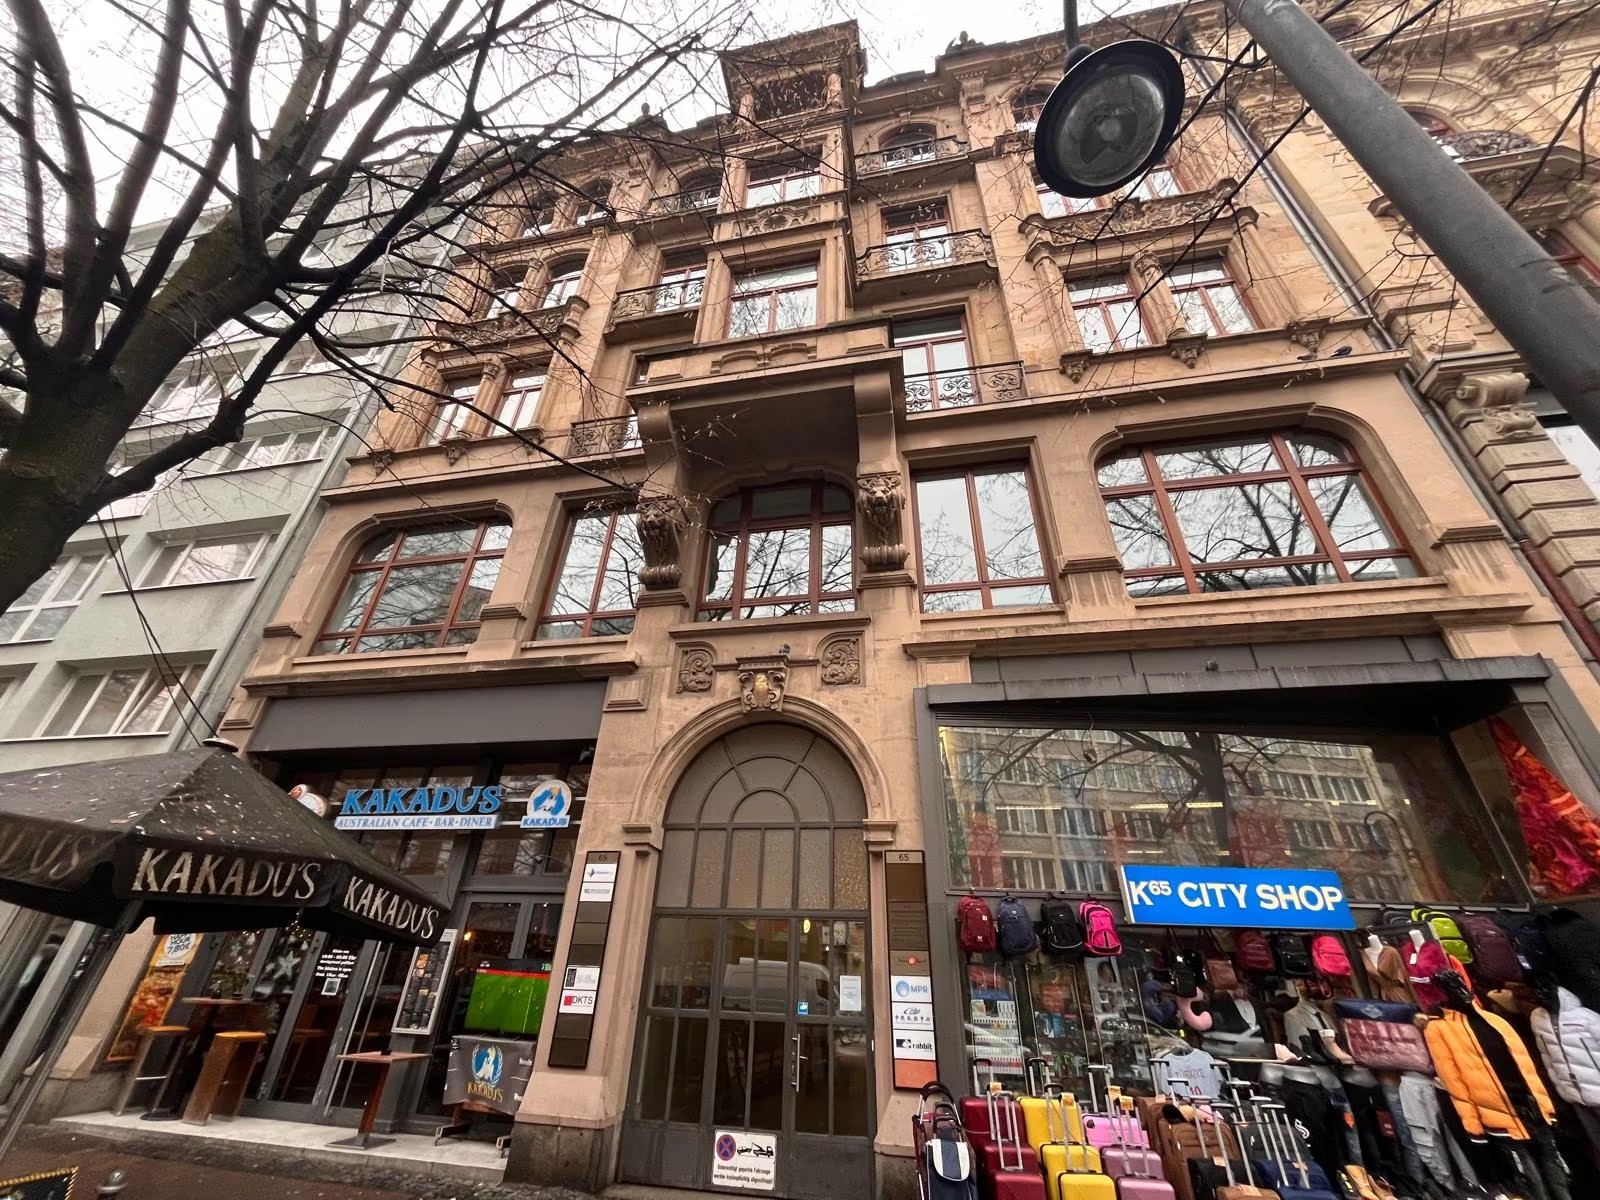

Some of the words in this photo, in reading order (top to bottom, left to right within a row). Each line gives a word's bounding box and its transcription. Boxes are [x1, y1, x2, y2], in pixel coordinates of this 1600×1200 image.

[339, 785, 503, 815] KAKADUS
[337, 817, 399, 829] AUSTRALIAN
[434, 816, 455, 828] BAR
[459, 816, 493, 828] DINER
[522, 817, 567, 827] KAKADUS
[898, 853, 910, 861] 65
[131, 847, 321, 900] KAKADU'S
[1178, 882, 1248, 909] CITY
[1256, 884, 1343, 912] SHOP
[343, 876, 439, 939] KAKADU'S
[910, 985, 928, 993] MPR
[573, 995, 594, 1005] DKTS
[912, 1042, 933, 1051] rabbit
